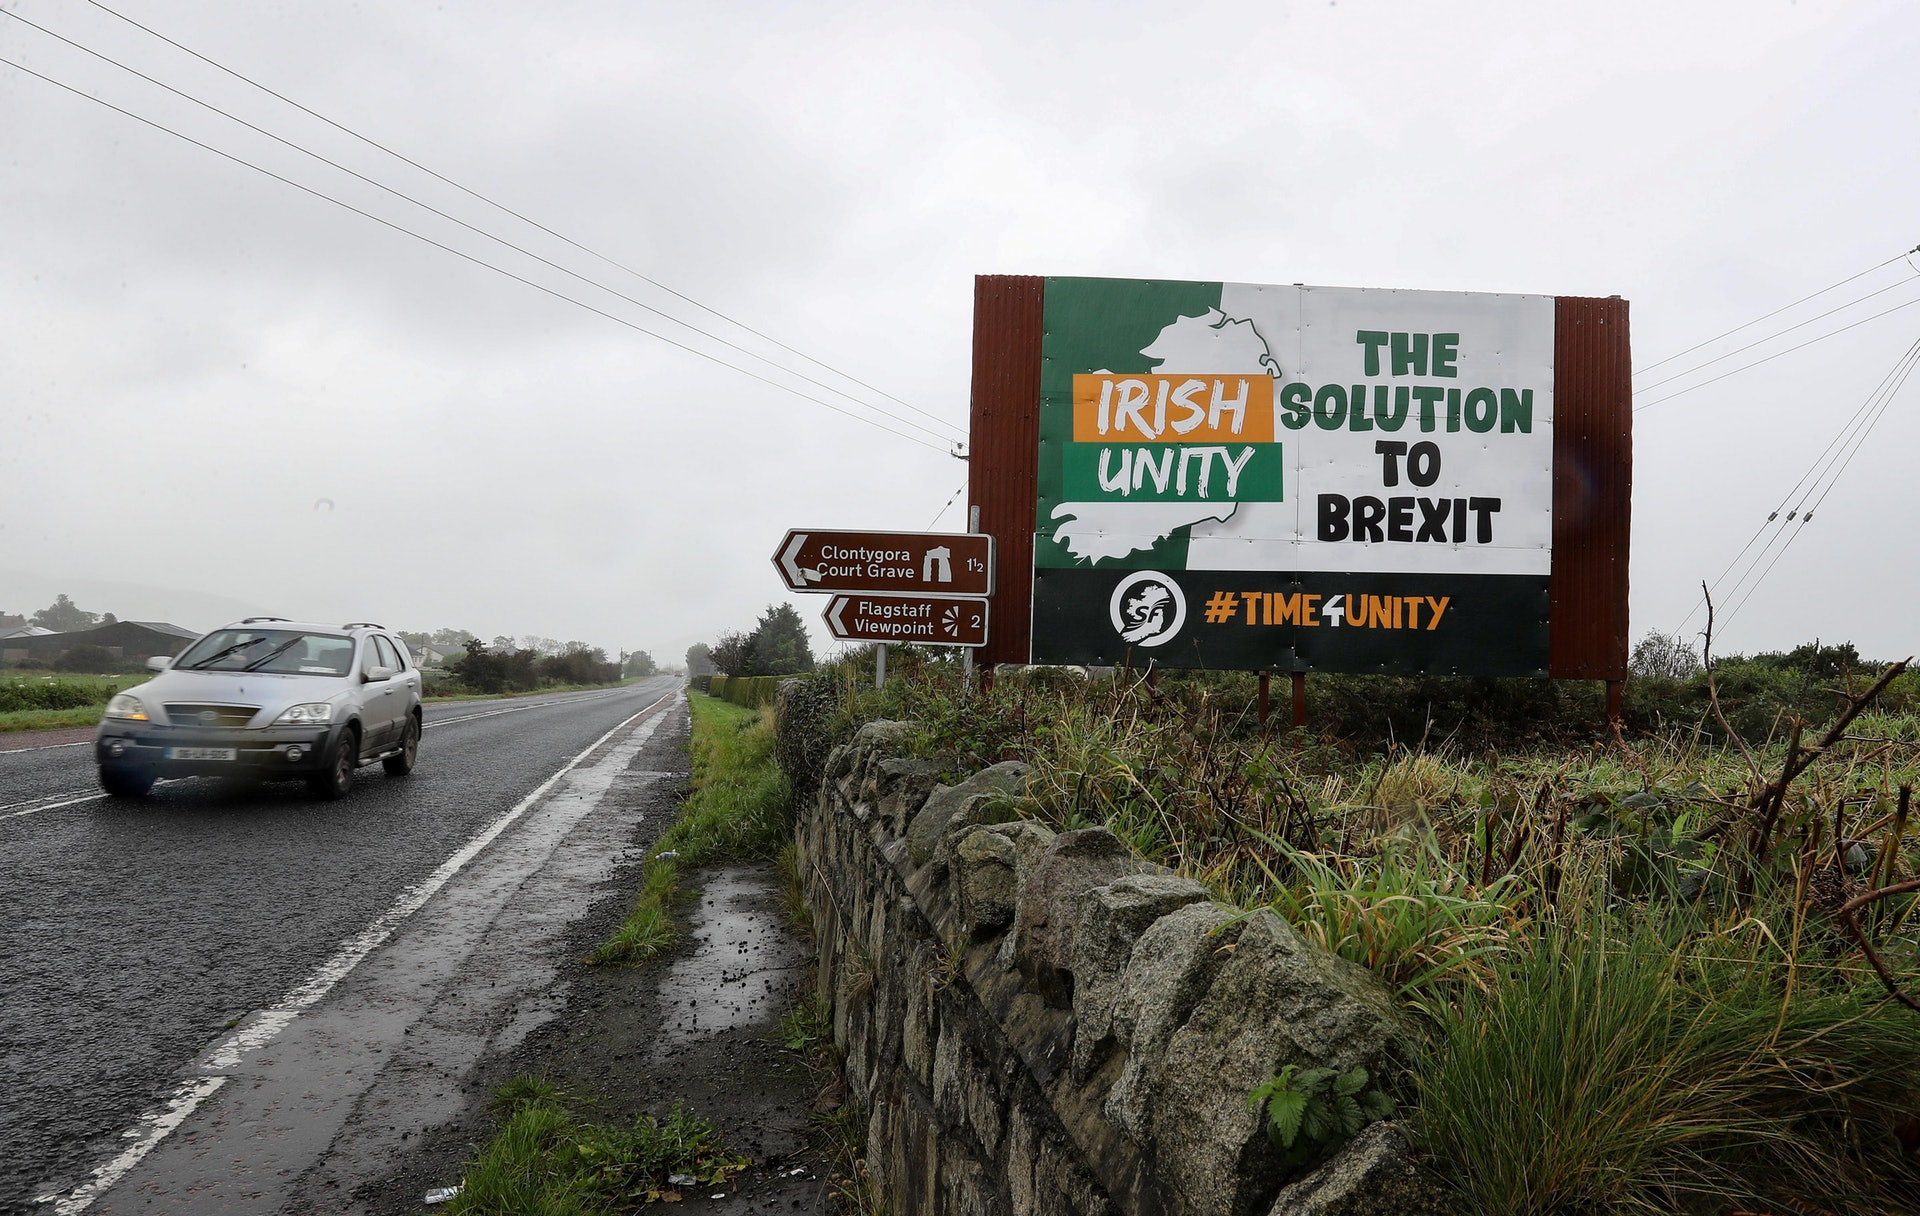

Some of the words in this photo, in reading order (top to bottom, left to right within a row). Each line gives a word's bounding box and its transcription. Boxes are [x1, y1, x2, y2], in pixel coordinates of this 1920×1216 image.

[1356, 330, 1459, 378] THE
[1097, 379, 1249, 440] IRISH
[1280, 382, 1533, 434] SOLUTION
[1098, 446, 1256, 499] UNITY
[1375, 440, 1441, 487] TO
[1317, 493, 1501, 544] BREXIT
[817, 563, 862, 577] Court
[867, 563, 915, 579] Grave
[821, 545, 910, 564] Clontygora
[855, 618, 934, 635] Viewpoint
[859, 601, 932, 618] Flagstaff
[971, 615, 980, 628] 2
[1204, 591, 1450, 630] #TIME4UNITY
